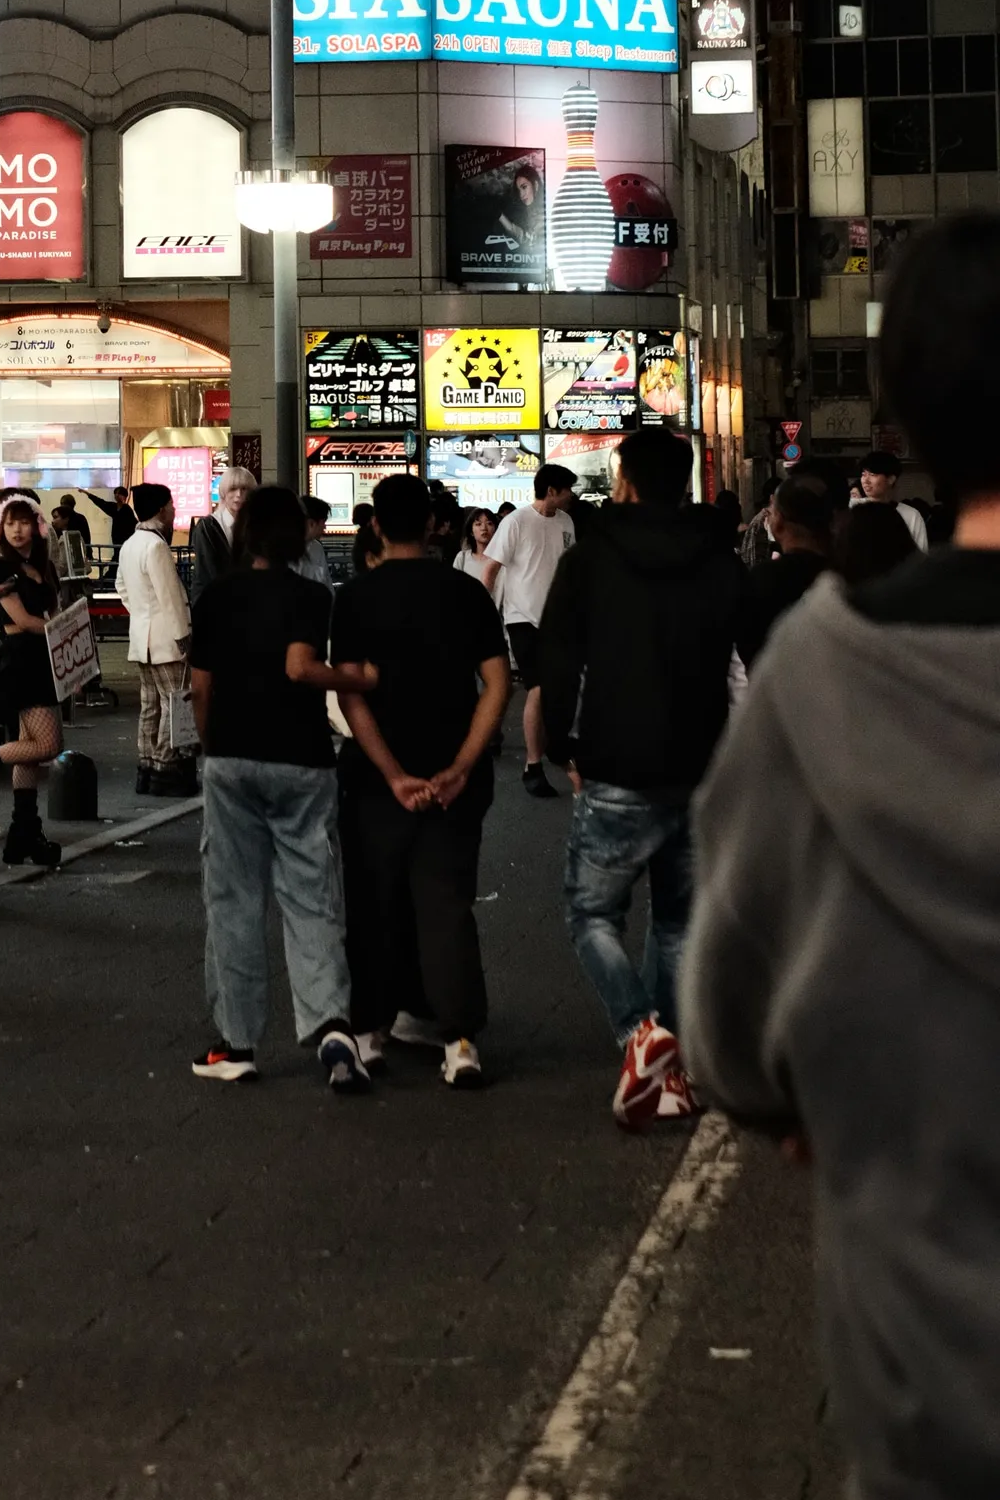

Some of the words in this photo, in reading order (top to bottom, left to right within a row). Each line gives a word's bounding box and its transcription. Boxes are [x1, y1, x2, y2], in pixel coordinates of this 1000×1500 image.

[329, 35, 380, 53] SOLA
[383, 33, 422, 52] SPA
[434, 33, 460, 51] 24h
[464, 34, 500, 53] OPEN
[576, 39, 612, 62] Sleep
[615, 44, 677, 63] Restaurant
[697, 39, 729, 49] SAUNA
[730, 38, 748, 48] 24h
[813, 149, 859, 174] AXY
[333, 170, 404, 188] 卓球バー
[350, 187, 405, 202] カラオケ
[350, 203, 405, 217] ビアポン
[364, 218, 405, 232] ダーツ
[136, 235, 233, 247] FACE
[319, 240, 342, 252] 東京
[342, 240, 372, 254] Ping
[460, 252, 502, 263] BRAVE
[505, 253, 543, 264] POINT
[29, 328, 99, 336] MO-MO-PARADISE
[306, 333, 319, 345] 5F
[543, 329, 563, 343] 4F
[9, 340, 56, 351] コパボウル
[7, 355, 34, 365] SOLA
[37, 355, 57, 365] SPA
[94, 353, 111, 362] 東京
[111, 353, 133, 363] Ping
[308, 361, 417, 378] ビリヤード&ダーツ
[309, 393, 356, 405] BAGUS
[442, 385, 480, 404] GAME
[483, 385, 522, 404] PANIC
[308, 438, 320, 449] 7F
[320, 442, 407, 456] FACE
[429, 437, 473, 455] Sleep
[500, 439, 520, 448] Room
[157, 455, 205, 470] 卓球バー
[515, 453, 540, 469] 24h
[167, 471, 205, 483] カラオケ
[463, 483, 535, 503] Sauna
[177, 496, 205, 508] ダーツ
